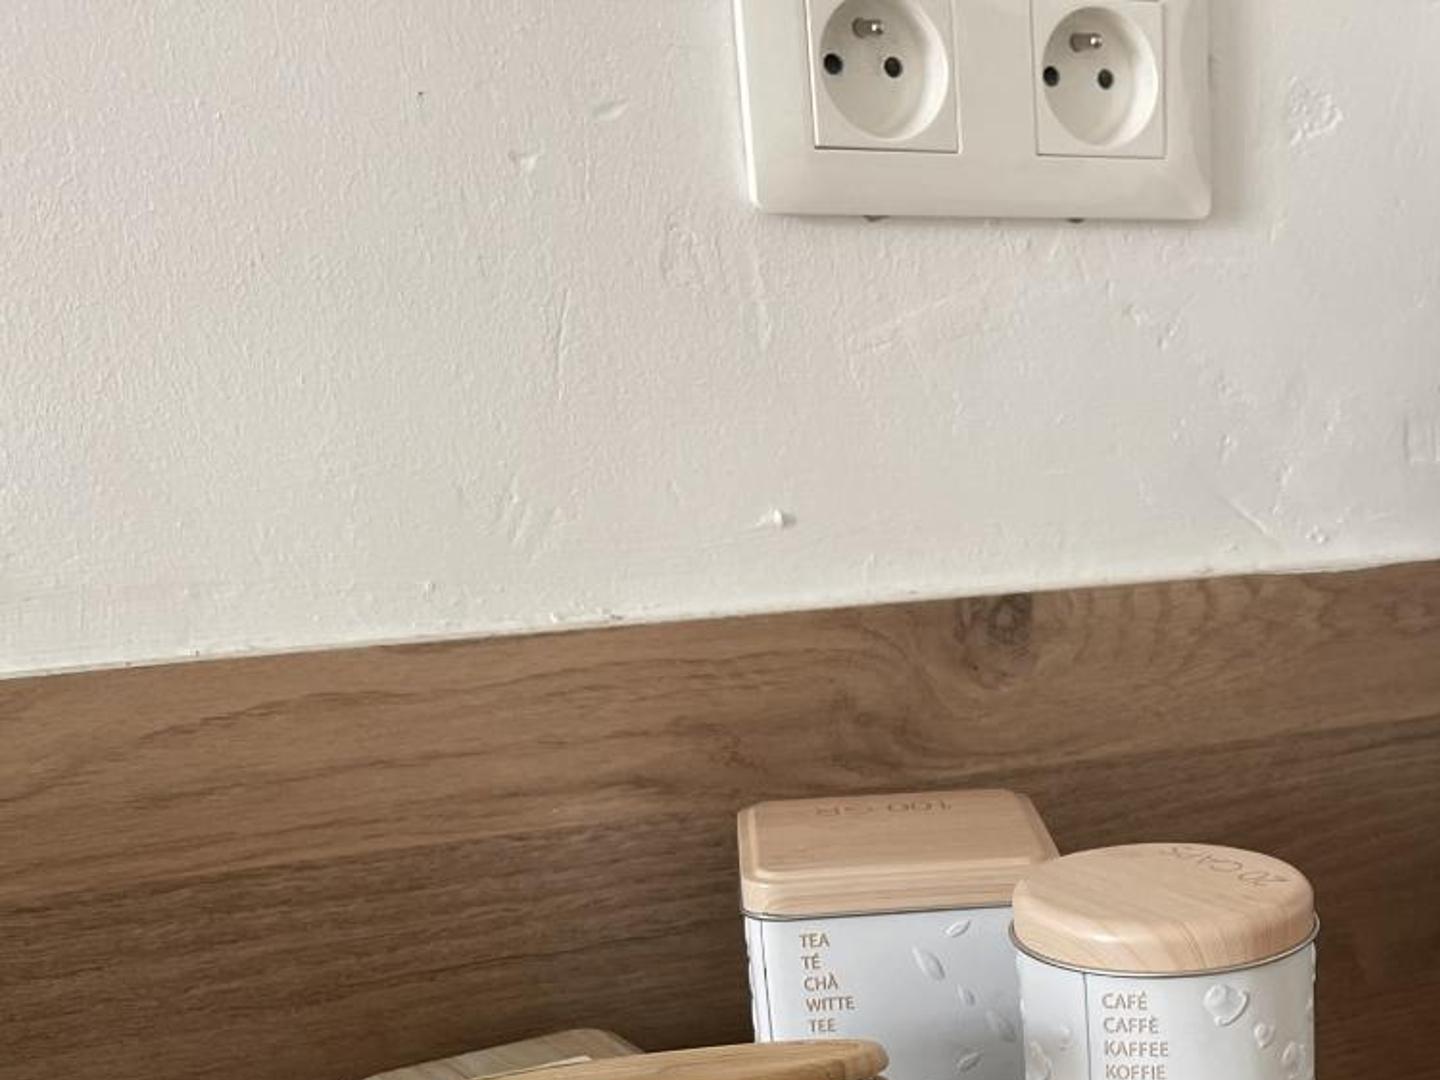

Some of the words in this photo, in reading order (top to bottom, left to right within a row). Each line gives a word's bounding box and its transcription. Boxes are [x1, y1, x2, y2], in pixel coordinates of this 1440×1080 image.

[799, 932, 830, 948] TEA
[801, 952, 821, 970] TÉ
[806, 996, 855, 1012] WITTE
[1101, 990, 1148, 1011] CAFÉ
[810, 1018, 837, 1033] TEE
[1104, 1040, 1169, 1057] KAFFEE
[1105, 1063, 1166, 1080] KOFFIE
